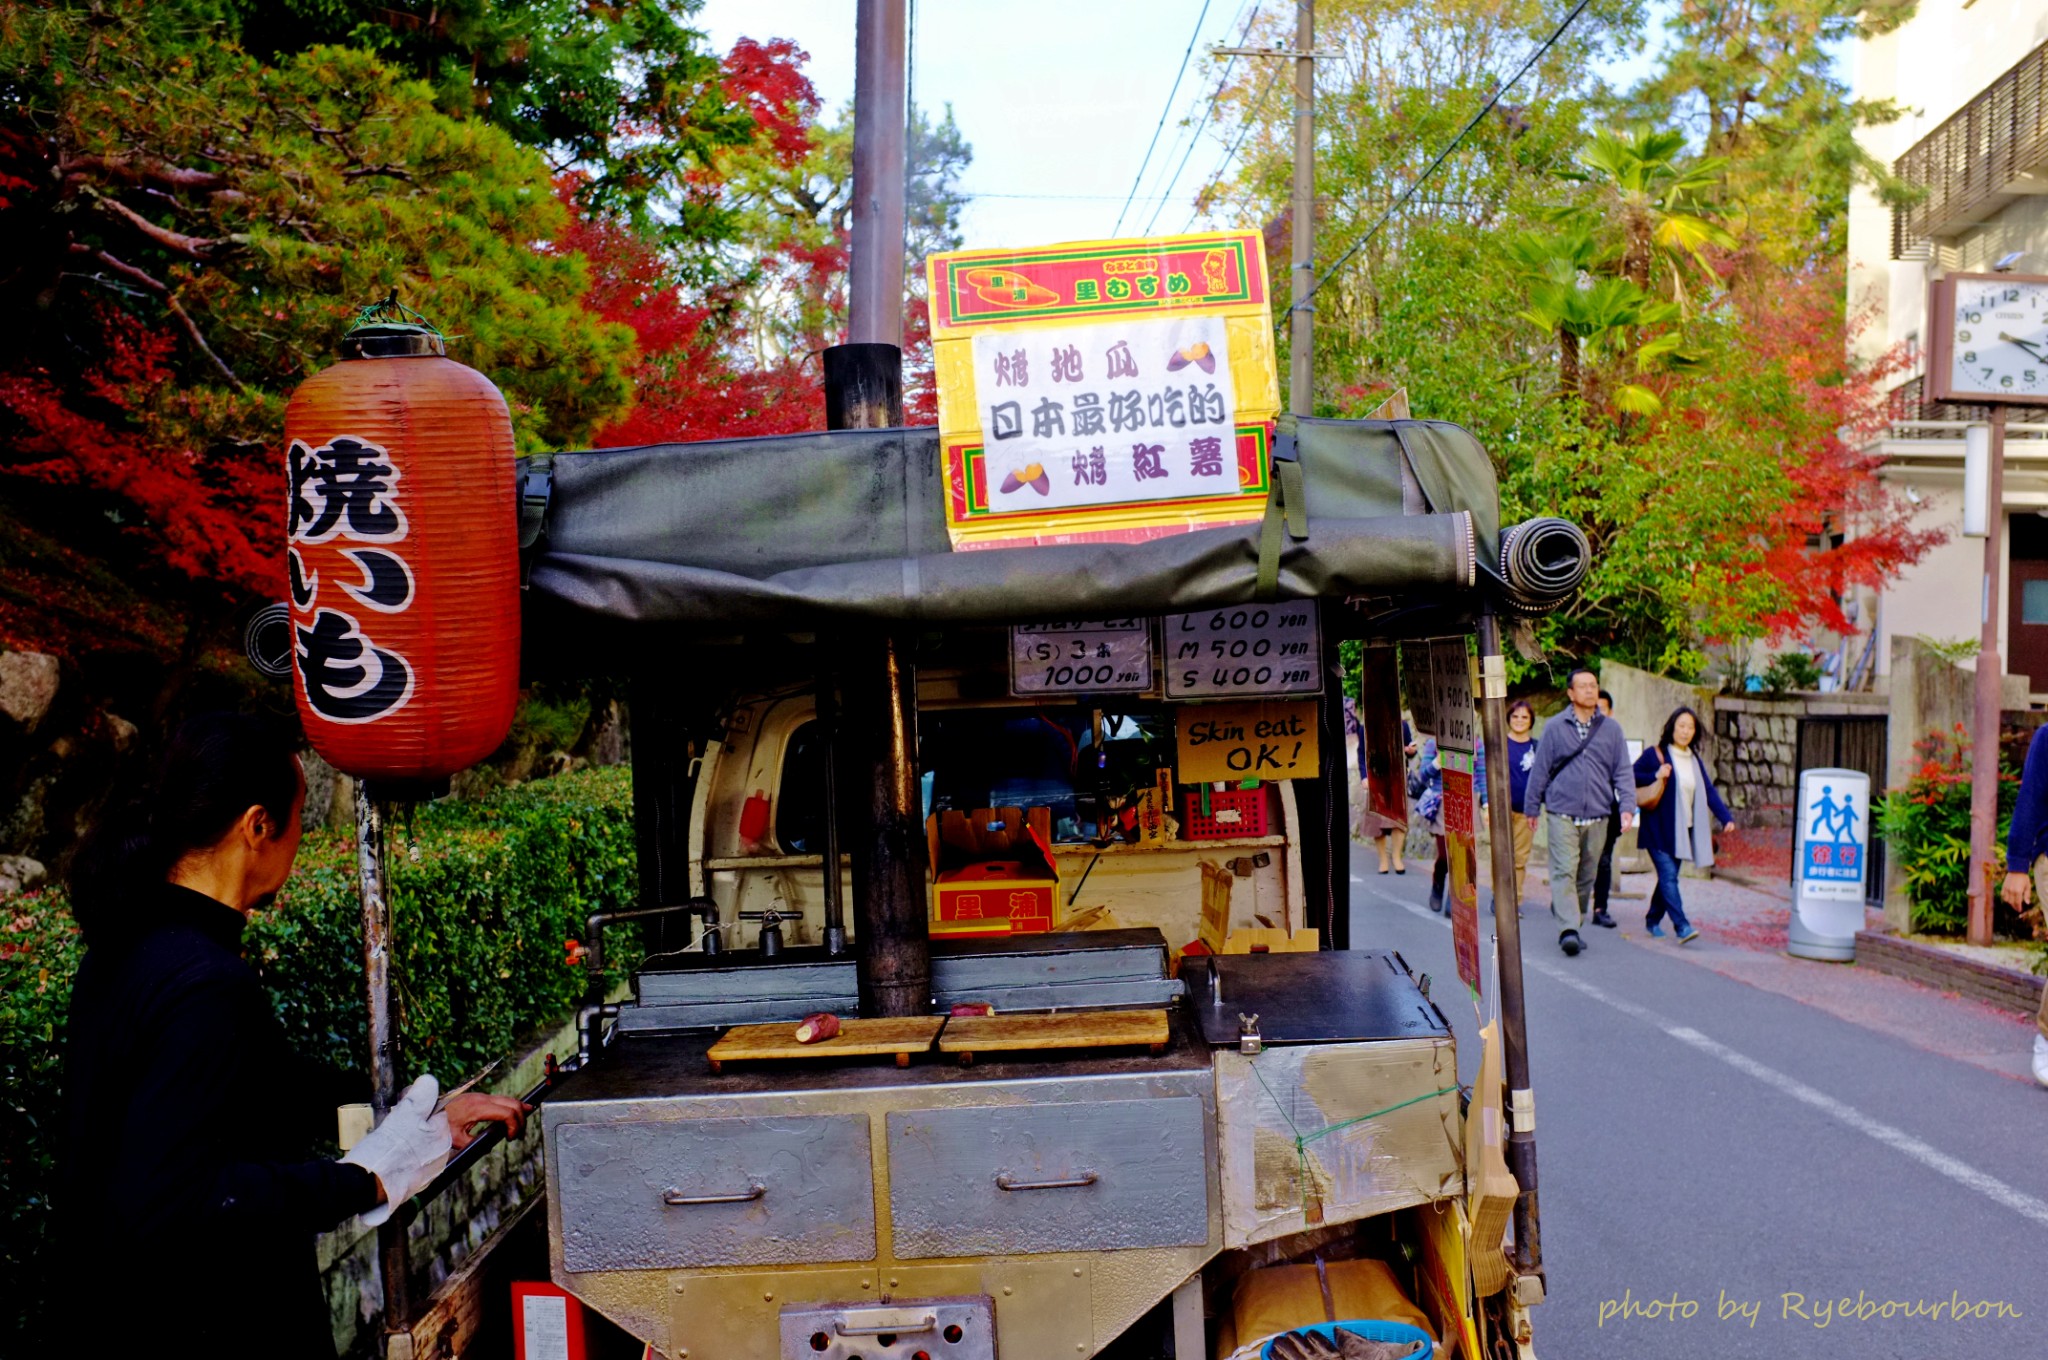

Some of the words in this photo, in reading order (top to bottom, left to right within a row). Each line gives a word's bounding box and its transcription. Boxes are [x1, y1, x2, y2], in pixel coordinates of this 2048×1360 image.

[1074, 273, 1192, 301] 里むすめ
[2003, 289, 2019, 302] 12
[1981, 296, 1994, 308] 11
[2032, 297, 2036, 308] 1
[1965, 312, 1981, 323] 10
[1995, 311, 2024, 320] CITIZEN
[1959, 330, 1972, 343] 9
[994, 340, 1139, 387] 烤地瓜
[1964, 351, 1977, 362] 8
[1981, 368, 1994, 380] 7
[2001, 375, 2013, 388] 6
[2024, 370, 2036, 382] 5
[990, 383, 1226, 440] 日本最好吃的
[1071, 436, 1223, 486] 烤紅薯
[287, 434, 414, 723] 焼いも
[1181, 613, 1196, 632] L
[1209, 610, 1270, 630] 600
[1278, 612, 1308, 629] yen
[1026, 643, 1061, 661] (S)
[1178, 641, 1199, 660] M
[1210, 638, 1271, 660] 500
[1279, 641, 1309, 657] yen
[1045, 665, 1113, 686] 1000
[1116, 671, 1140, 683] yen
[1183, 670, 1199, 688] S
[1212, 666, 1272, 687] 400
[1280, 669, 1311, 685] yen
[1188, 720, 1244, 746] Skin
[1254, 714, 1306, 739] eat
[1226, 741, 1303, 771] OK!
[1812, 845, 1856, 865] 徐行
